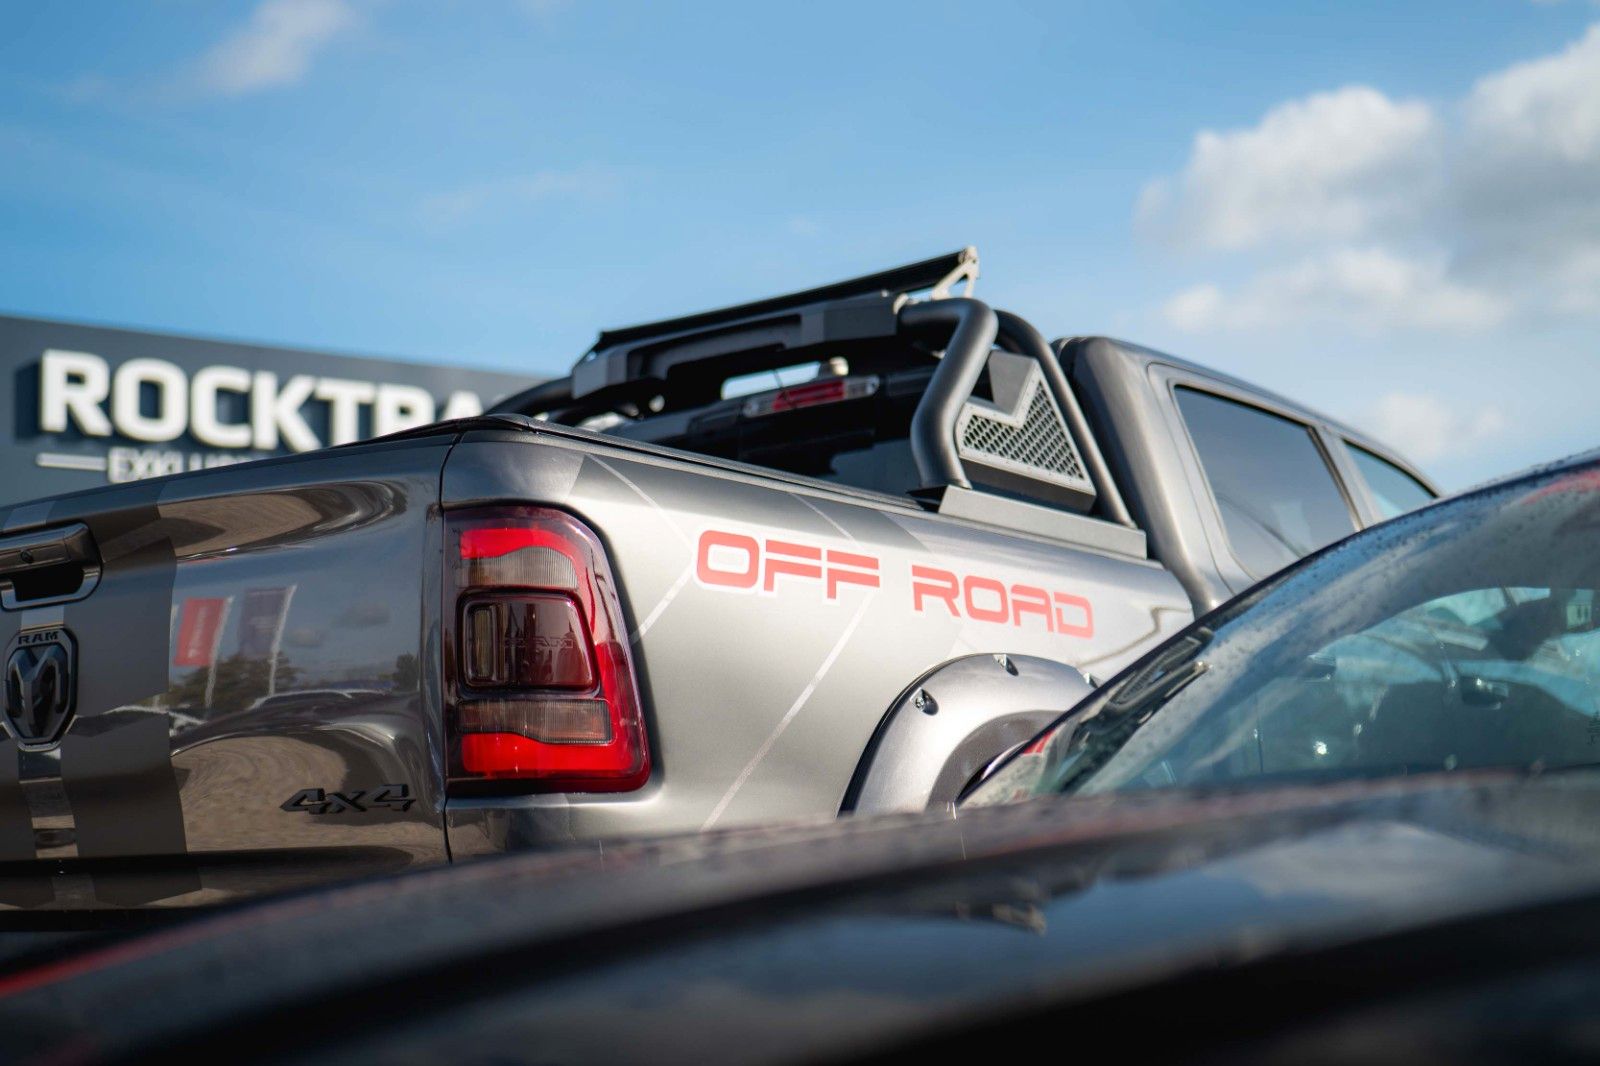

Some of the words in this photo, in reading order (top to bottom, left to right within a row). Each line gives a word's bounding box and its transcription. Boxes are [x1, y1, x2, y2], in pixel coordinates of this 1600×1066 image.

[697, 529, 880, 600] OFF
[911, 564, 1094, 640] ROAD
[18, 631, 59, 645] RAM
